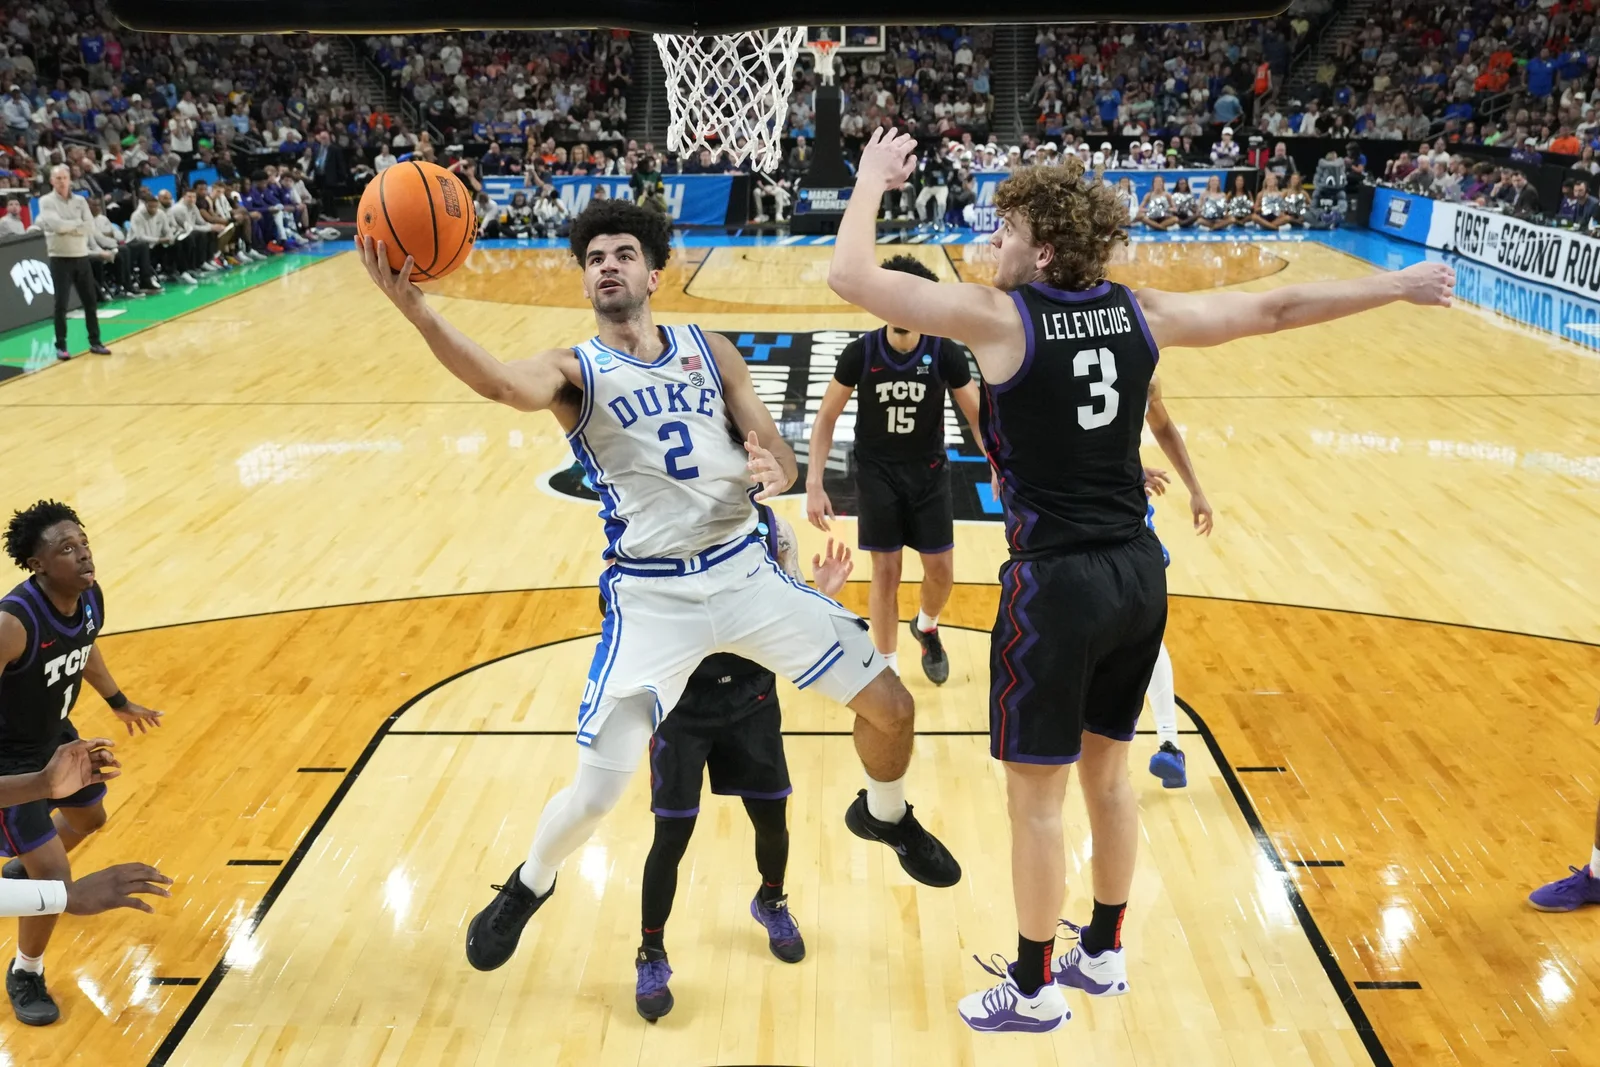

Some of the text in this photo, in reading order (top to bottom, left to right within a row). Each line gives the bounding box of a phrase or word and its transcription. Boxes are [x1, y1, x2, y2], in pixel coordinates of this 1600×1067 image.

[1454, 210, 1490, 257] FIRST
[1498, 222, 1563, 279] SECOND
[1042, 306, 1132, 340] LELEVICIUS
[608, 383, 716, 429] DUKE
[876, 381, 927, 404] TCU
[1072, 347, 1120, 430] 3
[886, 406, 917, 434] 15
[657, 420, 700, 480] 2
[44, 644, 93, 687] TCU
[60, 683, 74, 720] 1
